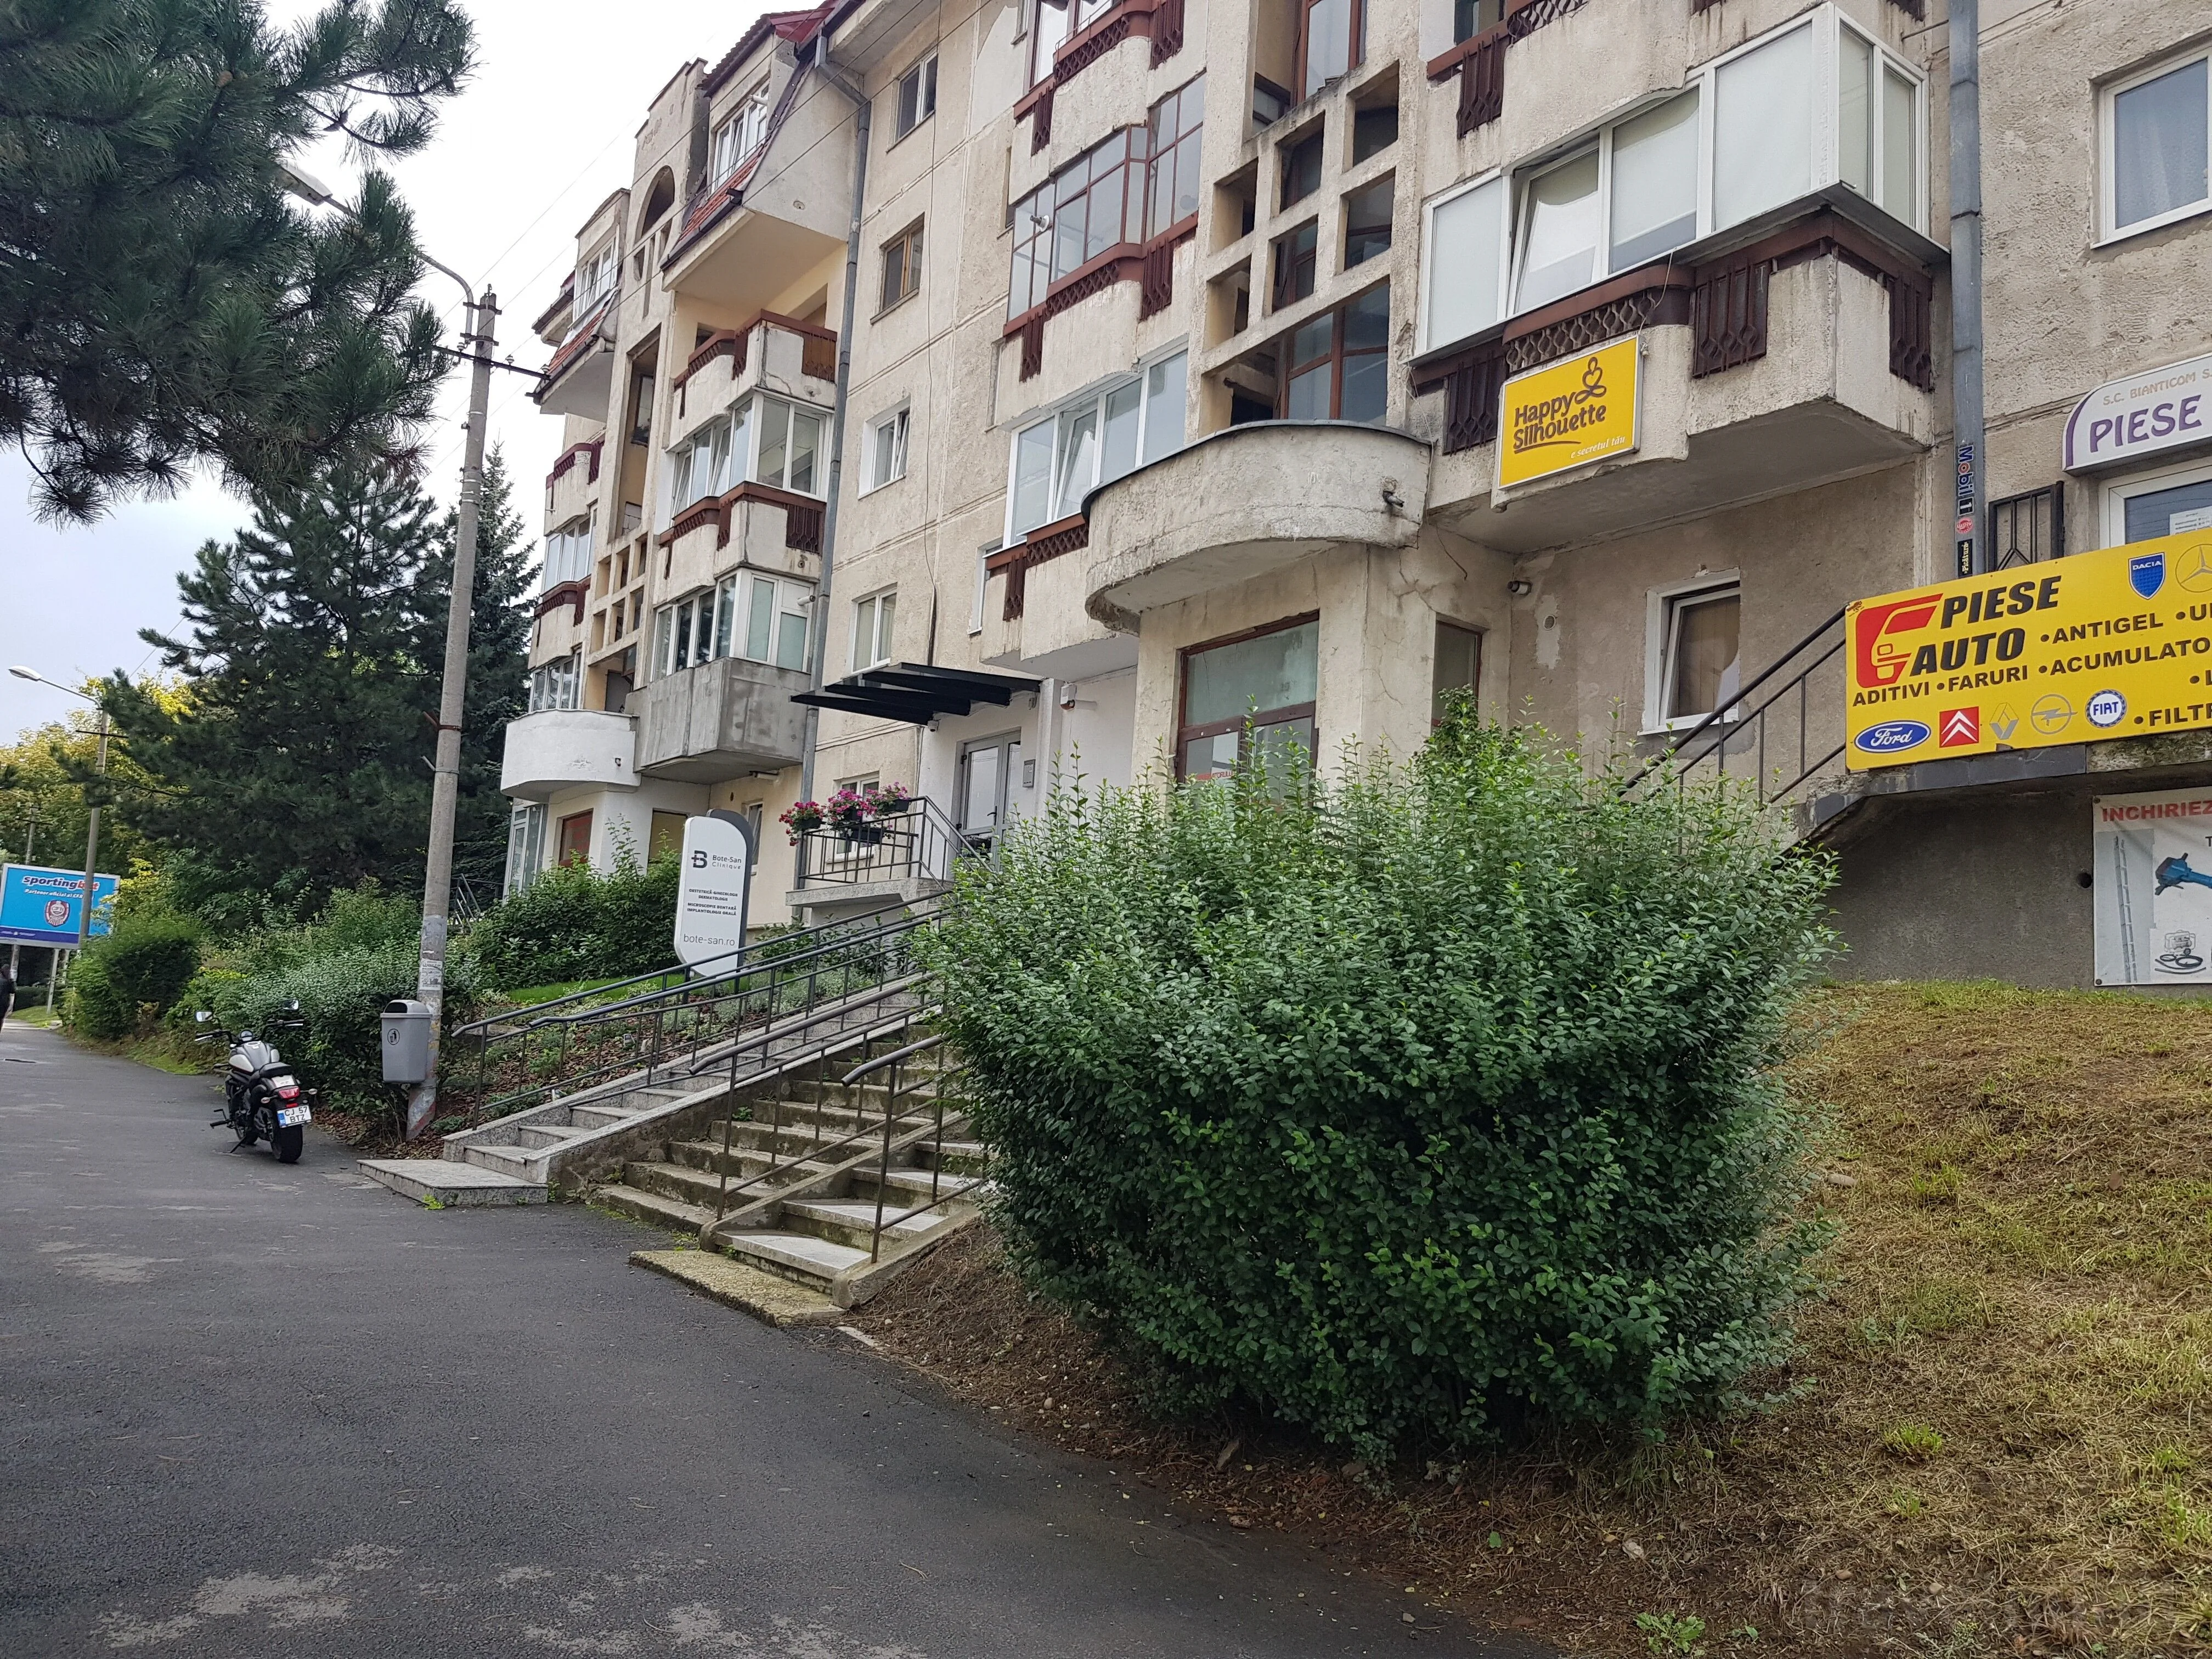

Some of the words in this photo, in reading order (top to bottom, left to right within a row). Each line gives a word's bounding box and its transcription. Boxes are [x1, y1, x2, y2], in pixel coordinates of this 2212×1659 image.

[2103, 393, 2125, 405] S.C.
[2130, 372, 2196, 399] BIANTICOM
[1513, 404, 1607, 449] Silhouette
[1514, 392, 1576, 427] Happy
[2090, 394, 2203, 453] PIESE
[1577, 439, 1610, 456] secretul
[1957, 445, 1974, 497] Mobil
[2132, 561, 2162, 571] DACIA
[1940, 575, 2062, 629] PIESE
[2052, 613, 2163, 644] ANTIGEL
[2190, 602, 2212, 620] U
[1909, 628, 2025, 676] AUTO
[2050, 637, 2210, 675] ACUMULATO
[1852, 681, 1929, 707] ADITIVI
[1948, 665, 2028, 692] FARURI
[2093, 702, 2119, 715] FIAT
[1871, 726, 1913, 747] Ford
[713, 855, 742, 864] Bote-San
[23, 877, 99, 890] sportingbt
[684, 934, 735, 946] bote-san.ro
[290, 1114, 306, 1122] BTZ
